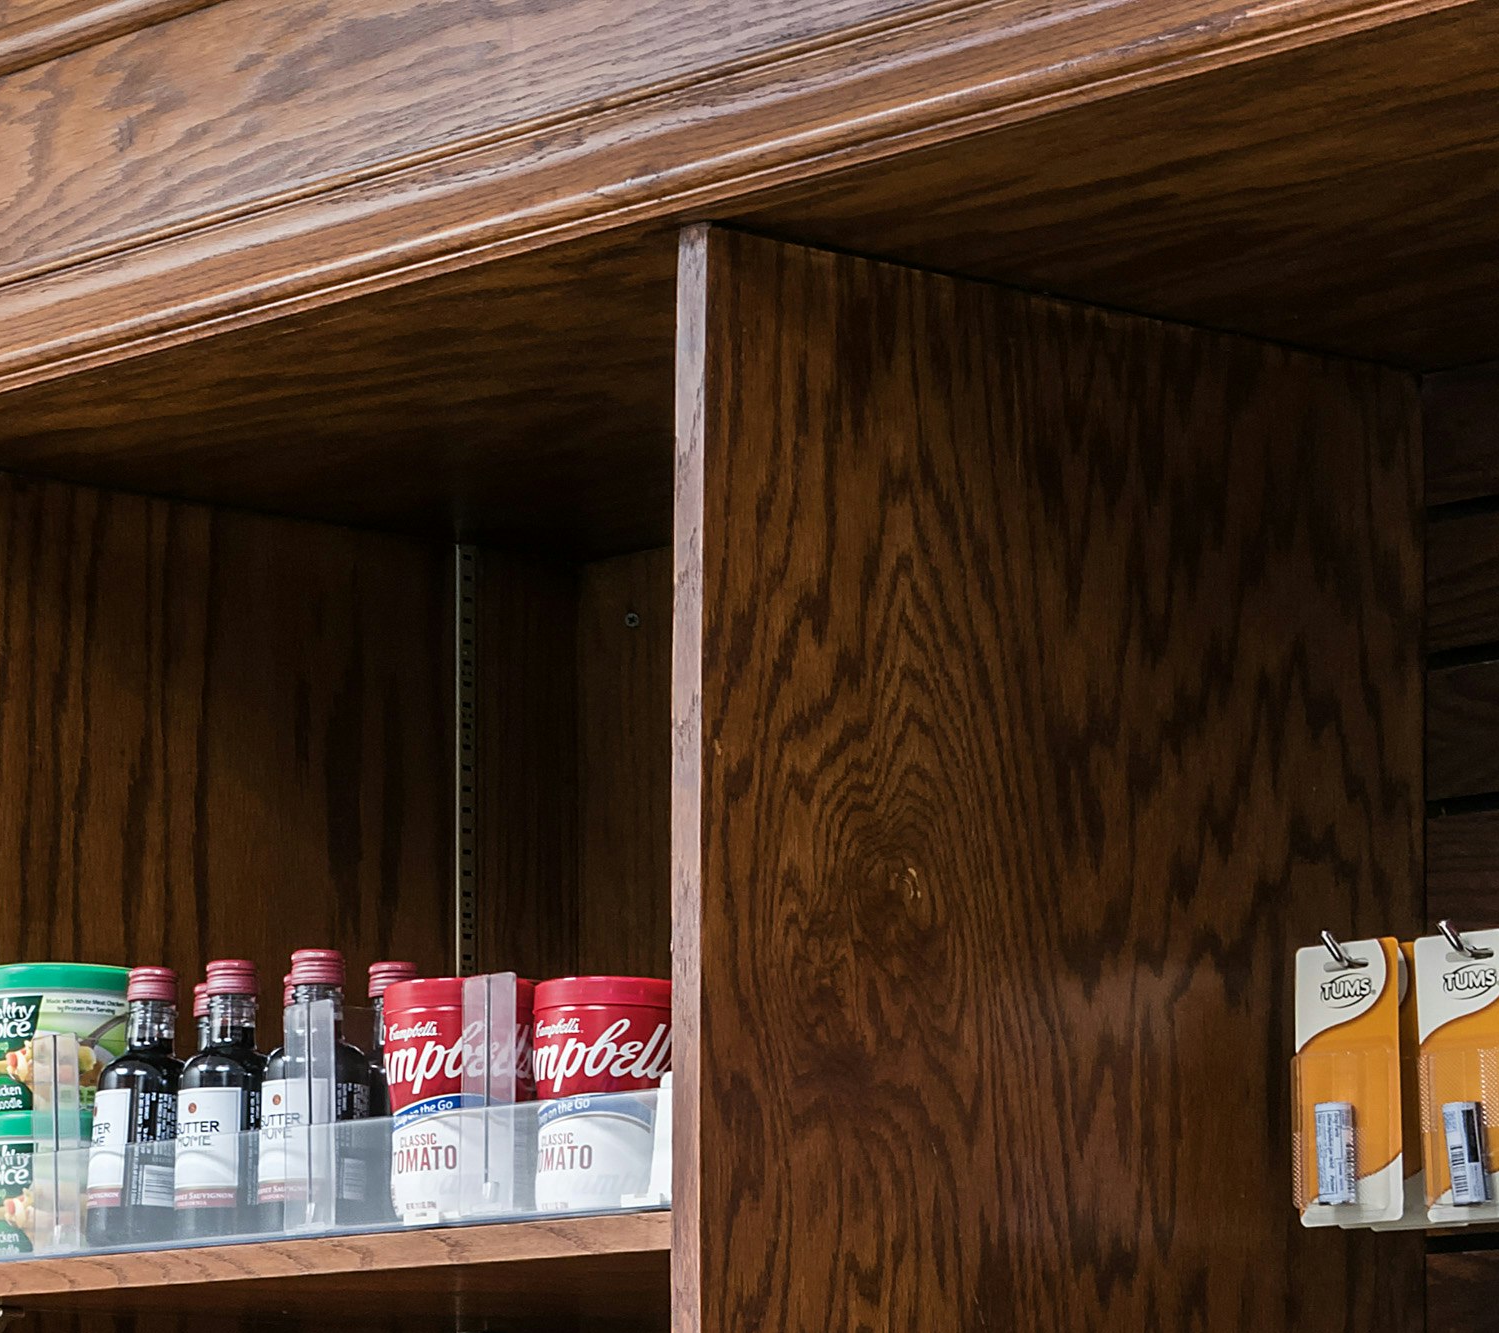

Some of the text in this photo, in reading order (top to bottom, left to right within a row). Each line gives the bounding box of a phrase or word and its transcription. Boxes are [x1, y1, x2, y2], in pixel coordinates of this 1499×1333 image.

[1321, 977, 1372, 1001] TUMS
[1443, 968, 1498, 993] TUMS
[389, 1021, 438, 1041] Campbell's
[177, 1120, 220, 1134] SUTTER
[260, 1112, 301, 1126] SUTTER
[177, 1132, 212, 1147] HOME
[400, 1132, 437, 1149] CLASSIC
[541, 1132, 574, 1148] CLASSIC
[393, 1145, 458, 1175] TOMATO
